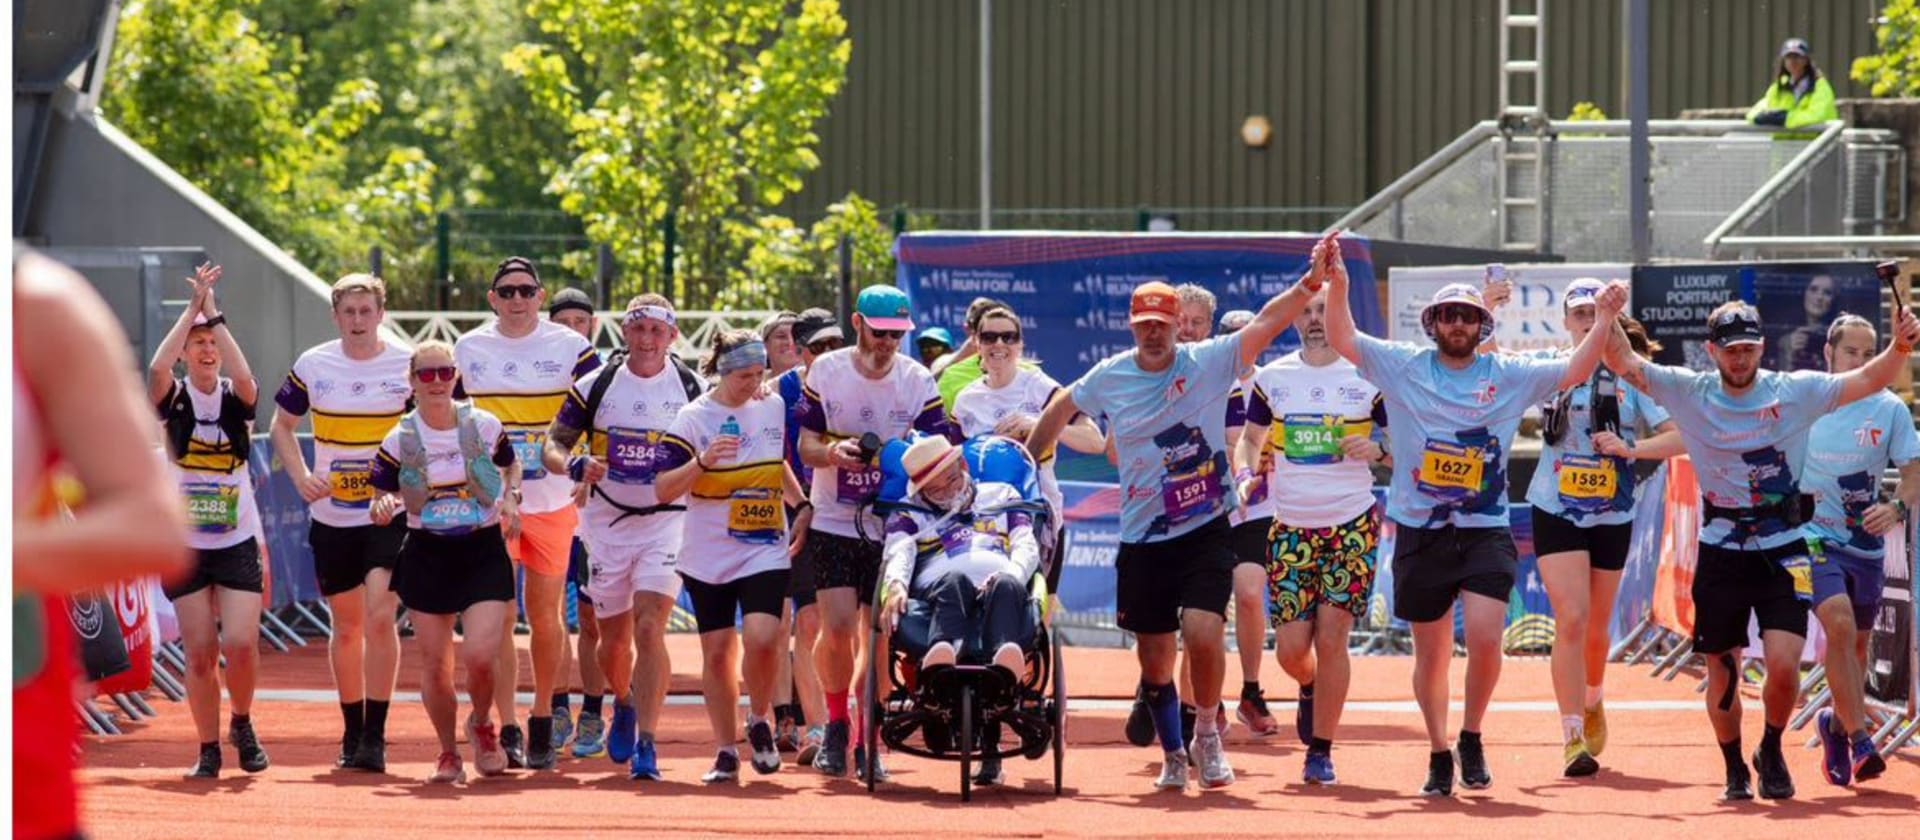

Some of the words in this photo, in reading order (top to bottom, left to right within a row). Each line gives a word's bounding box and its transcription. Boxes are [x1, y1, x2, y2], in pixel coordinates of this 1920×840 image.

[951, 279, 980, 291] RUN
[983, 280, 1010, 292] FOR
[1012, 281, 1038, 293] ALL
[1673, 274, 1728, 289] LUXURY
[1666, 289, 1731, 304] PORTRAIT
[1641, 307, 1693, 321] STUDIO
[1293, 430, 1334, 445] 3914
[616, 443, 657, 460] 2584
[1433, 458, 1474, 476] 1627
[340, 476, 370, 490] 389
[845, 470, 882, 486] 2319
[1570, 471, 1608, 487] 1582
[1174, 479, 1208, 503] 1591
[189, 500, 227, 514] 2388
[740, 504, 775, 519] 3469
[1067, 546, 1096, 568] RUN
